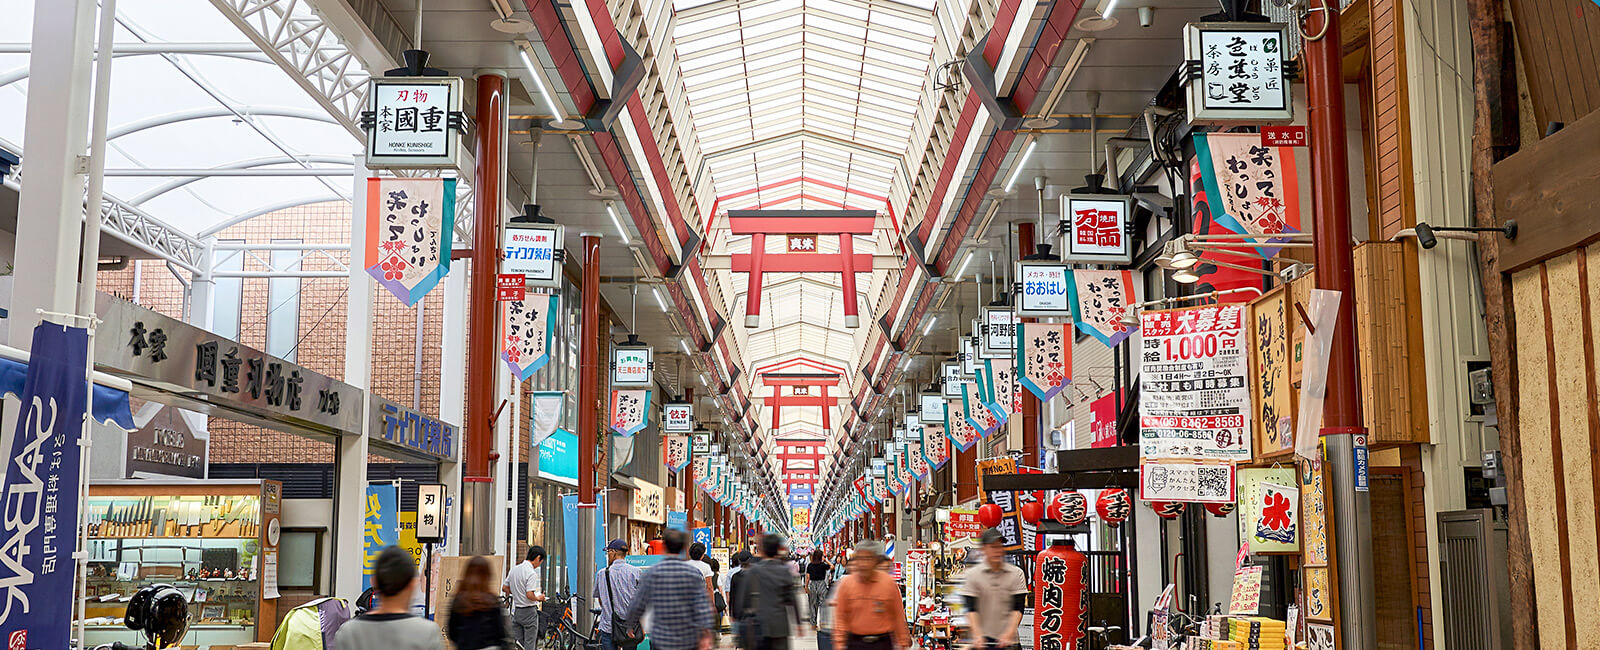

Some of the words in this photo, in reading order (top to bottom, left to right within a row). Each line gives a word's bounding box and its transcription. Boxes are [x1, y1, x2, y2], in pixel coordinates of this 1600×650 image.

[1205, 44, 1223, 77] 茶房
[1263, 57, 1280, 90] 菓匠
[396, 89, 428, 103] 刃物
[379, 105, 393, 133] 本家
[395, 106, 444, 133] 國重
[1267, 131, 1304, 140] 送水口
[1249, 145, 1274, 198] 笑って
[1226, 155, 1253, 221] わっしょい
[1100, 214, 1116, 223] 焼肉
[1025, 281, 1066, 295] おおはし
[1087, 282, 1106, 323] わっしょい
[1102, 277, 1120, 307] 笑って
[1174, 305, 1240, 335] 大募集
[1033, 336, 1046, 379] わっしょい
[1046, 330, 1061, 363] 笑って
[1143, 338, 1161, 363] 時給
[1146, 377, 1241, 391] 正社員も同時募集
[669, 409, 688, 419] 餃子
[1181, 416, 1241, 428] 6462-8568
[423, 493, 435, 526] 刃物
[1262, 492, 1291, 531] 氷
